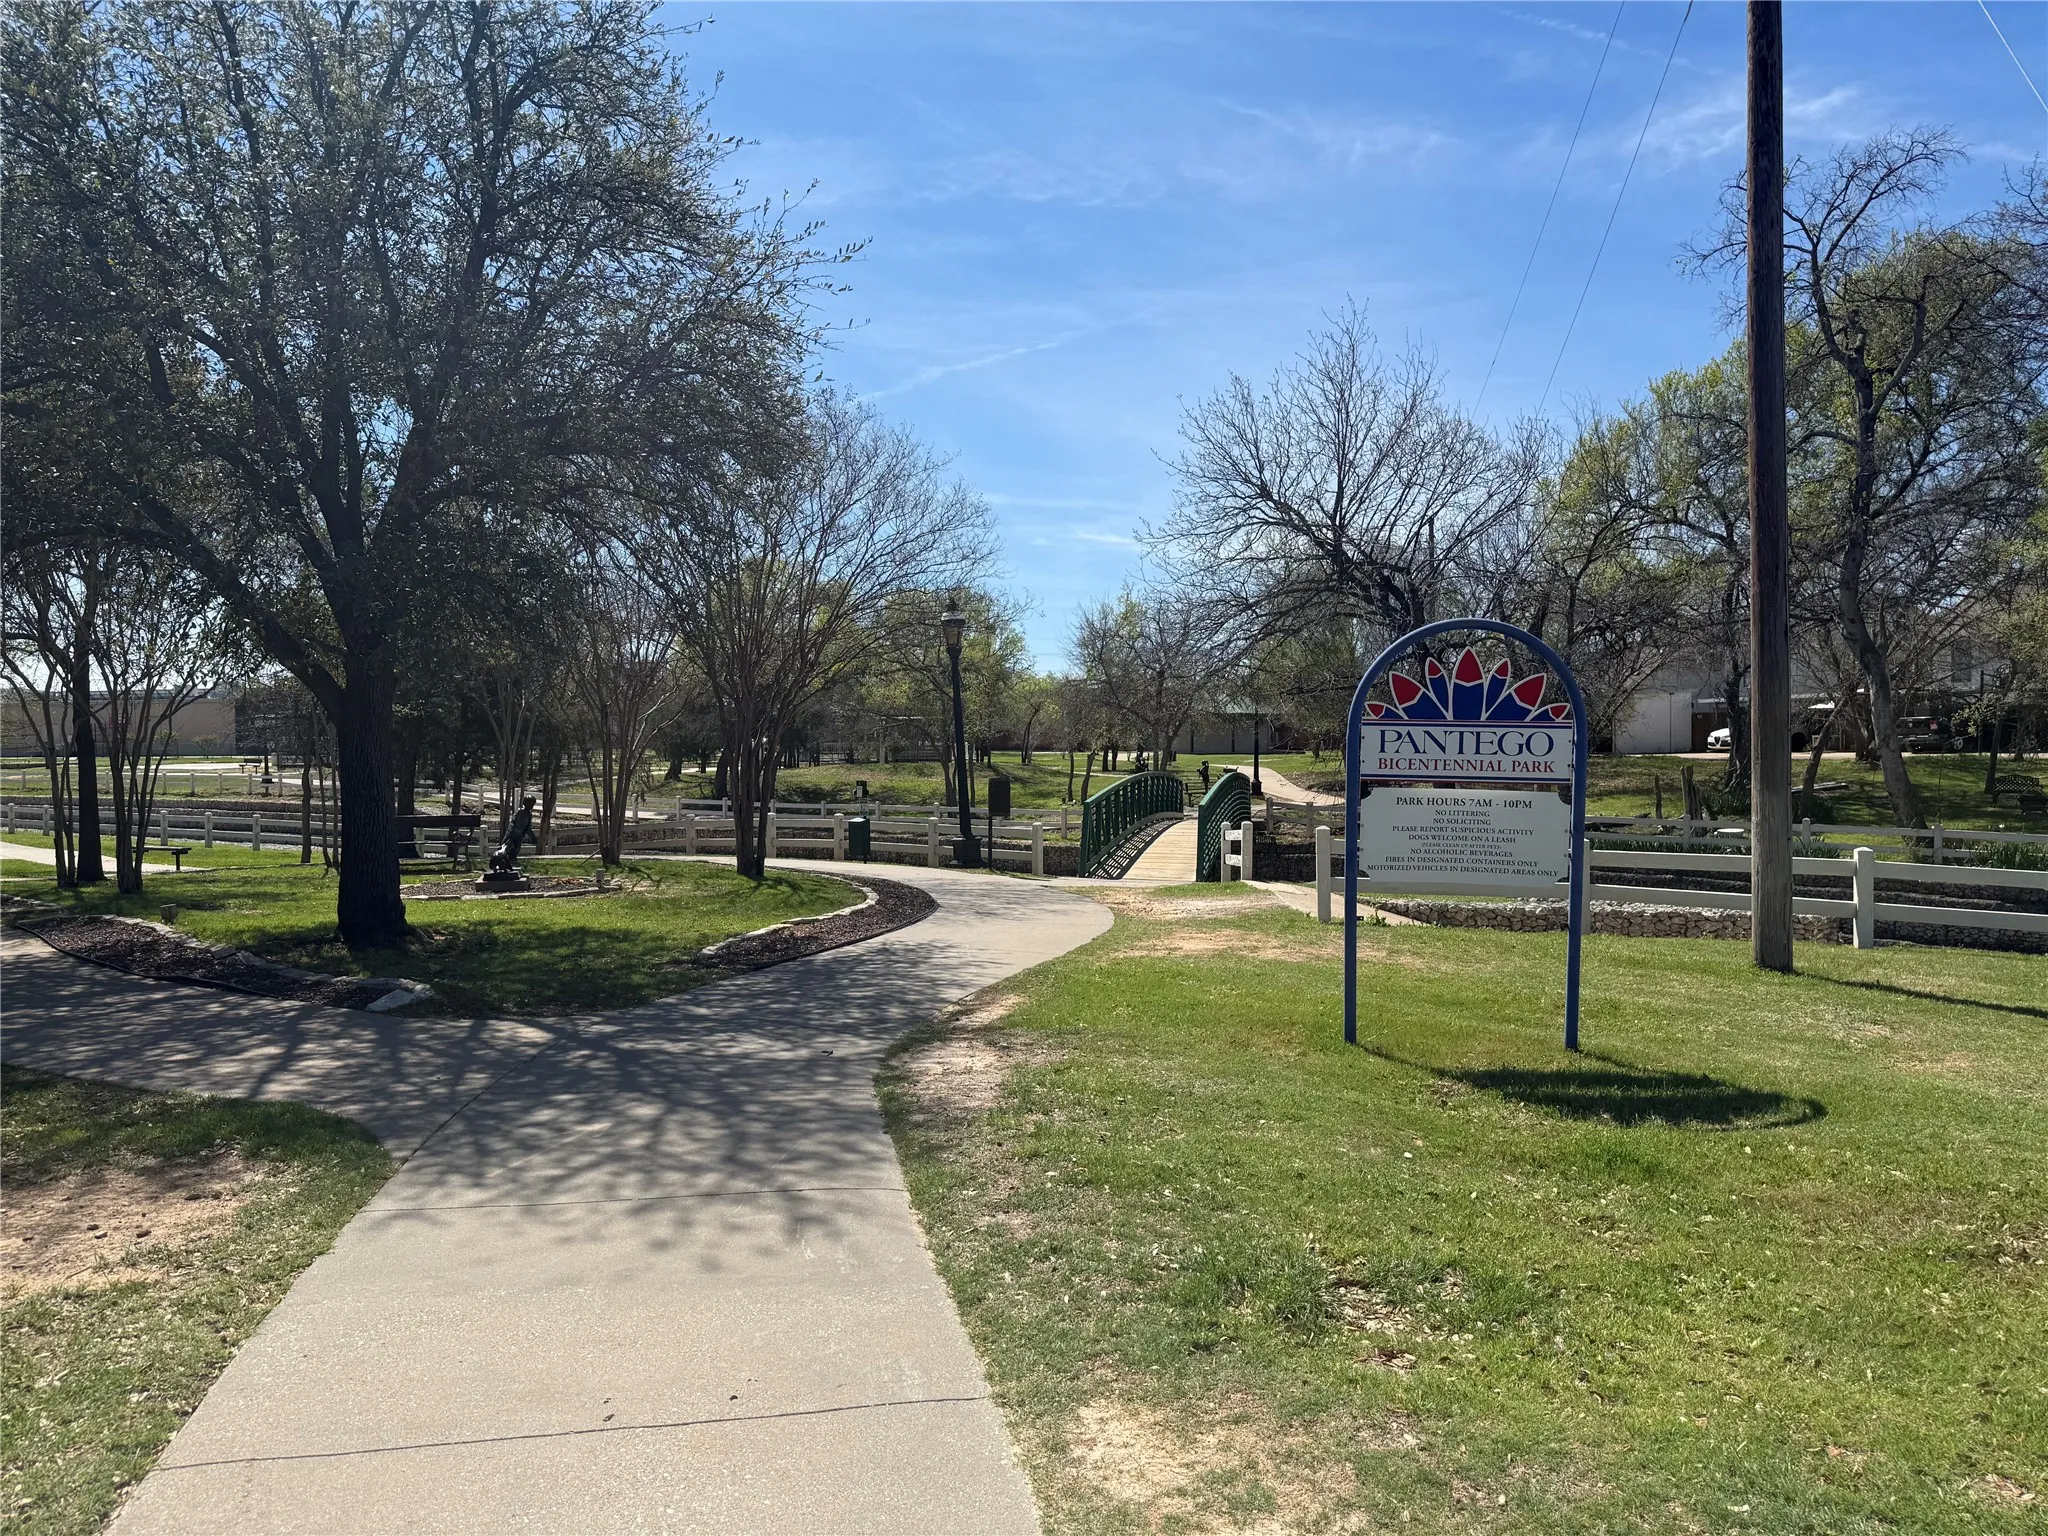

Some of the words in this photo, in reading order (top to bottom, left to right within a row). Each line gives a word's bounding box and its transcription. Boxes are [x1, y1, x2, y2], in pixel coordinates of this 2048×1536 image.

[1379, 729, 1554, 756] PANTEGO
[1378, 758, 1506, 772] BICENTENNIAL
[1511, 760, 1555, 773] PARK
[1396, 797, 1424, 805] PARK
[1427, 797, 1465, 806] HOURS
[1469, 799, 1492, 807] 7AM
[1504, 800, 1532, 808] 10PM
[1467, 858, 1515, 866] CONTAINERS
[1460, 866, 1509, 874] DESIGNATED
